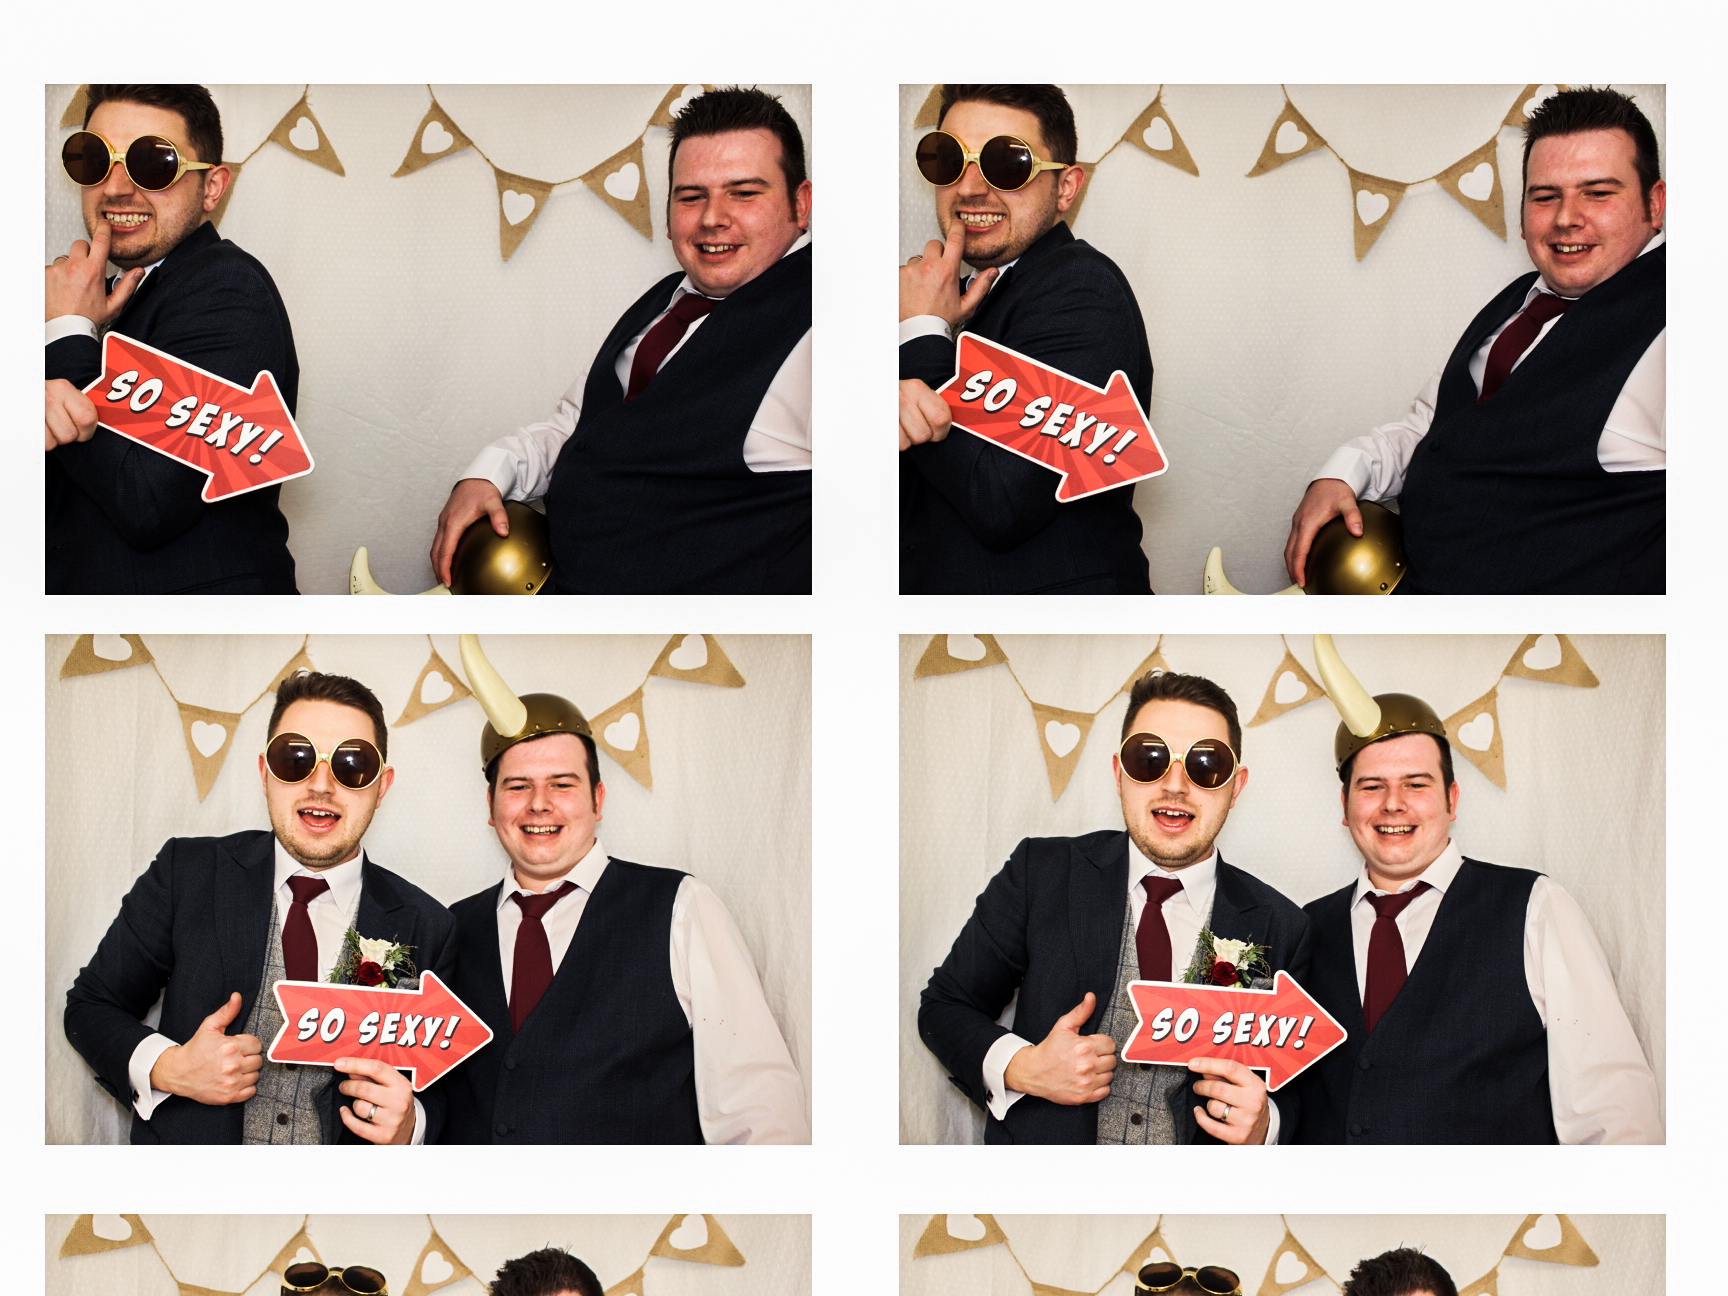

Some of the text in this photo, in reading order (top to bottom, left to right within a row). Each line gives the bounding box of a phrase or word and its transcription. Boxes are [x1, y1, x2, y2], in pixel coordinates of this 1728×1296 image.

[106, 370, 284, 465] SO SEXY!
[960, 370, 1138, 465] SO SEXY!
[297, 1007, 461, 1049] SO SEXY!
[1151, 1007, 1315, 1049] SO SEXY!
